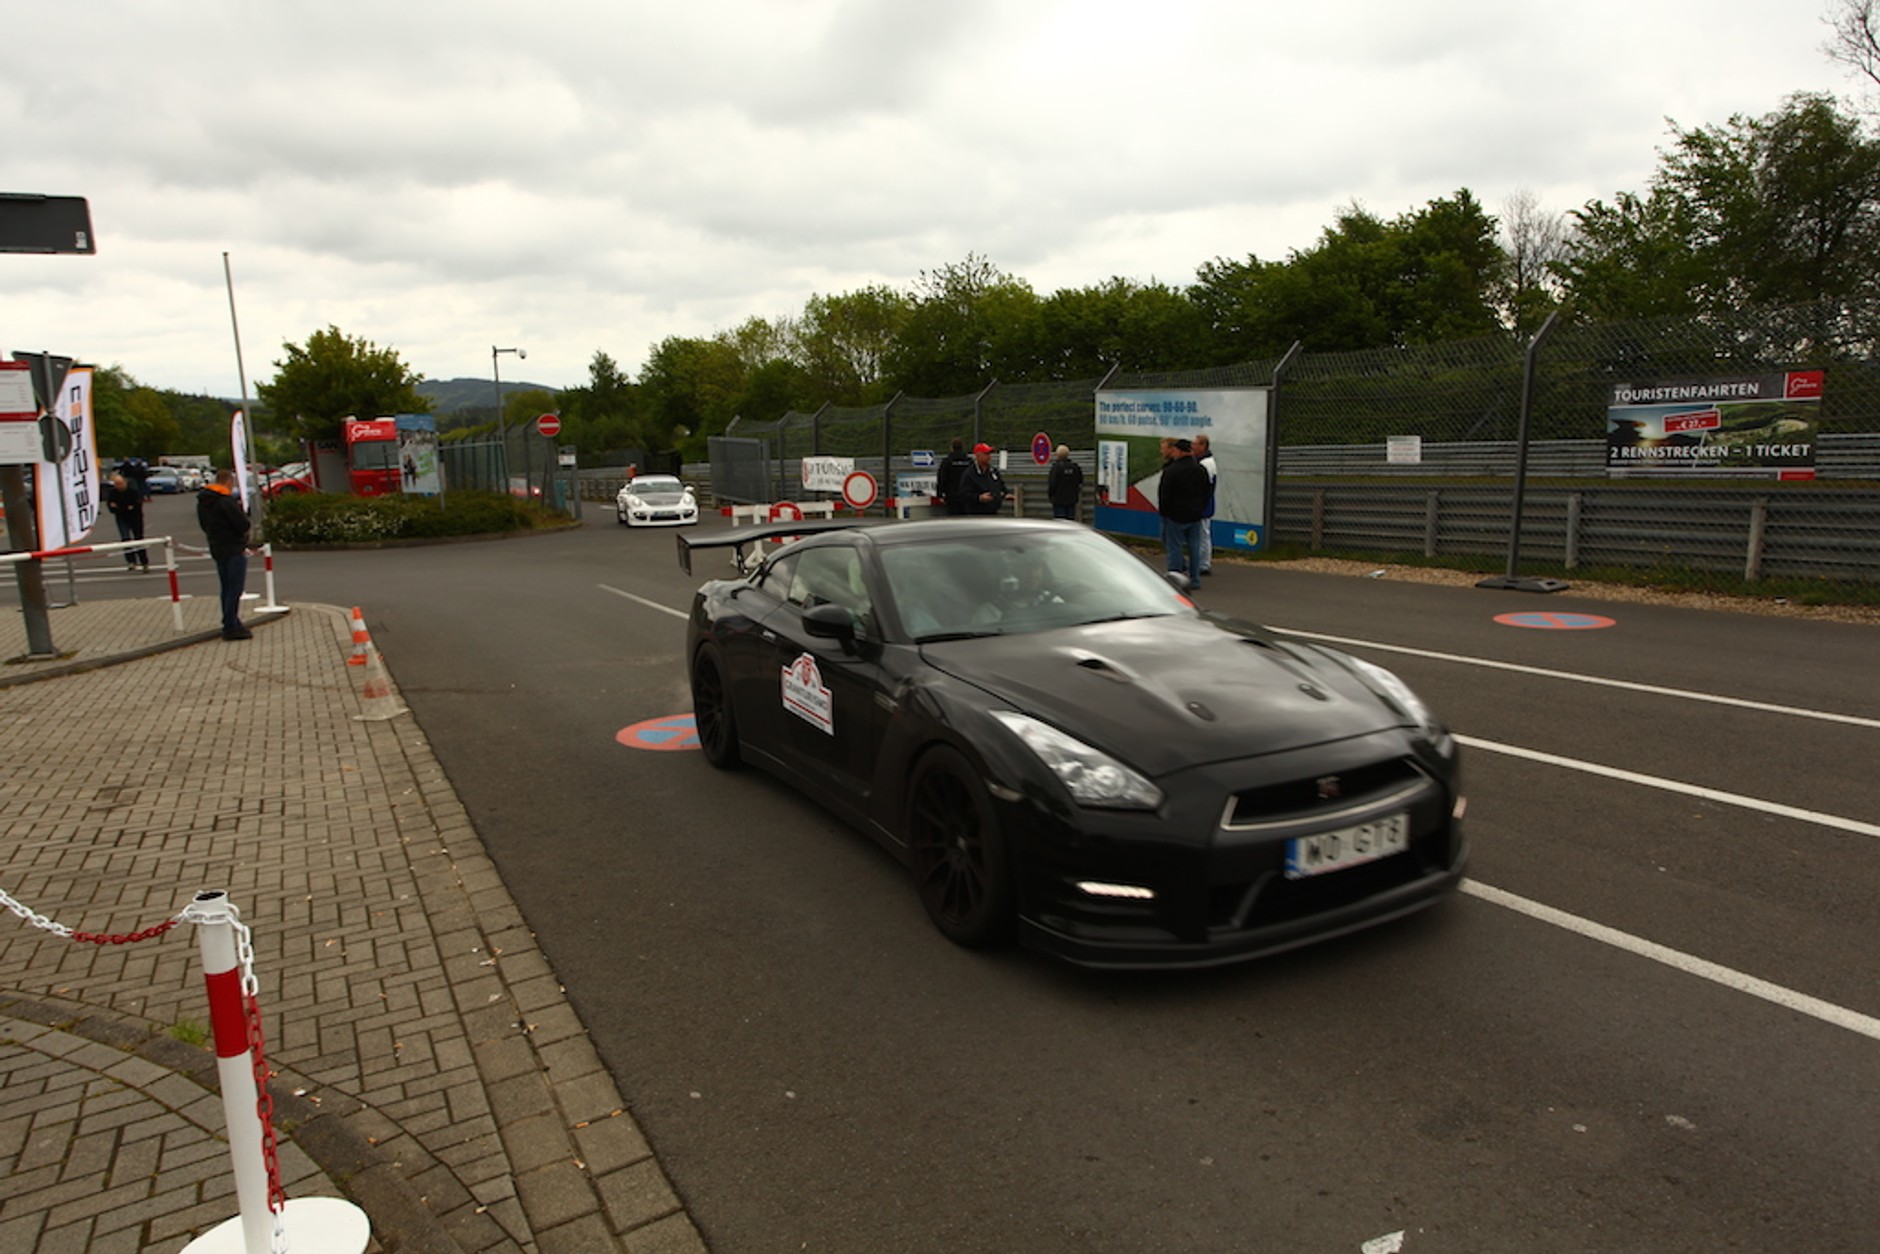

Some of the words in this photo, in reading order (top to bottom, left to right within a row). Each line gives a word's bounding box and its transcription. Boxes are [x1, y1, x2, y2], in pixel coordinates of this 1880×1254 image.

[1614, 382, 1759, 402] TOURISTENFAHRTEN
[1099, 401, 1110, 412] The
[1610, 446, 1620, 459] 2
[1622, 445, 1729, 459] RENNSTRECKEN
[1745, 445, 1752, 457] 1
[1756, 444, 1811, 457] TICKET
